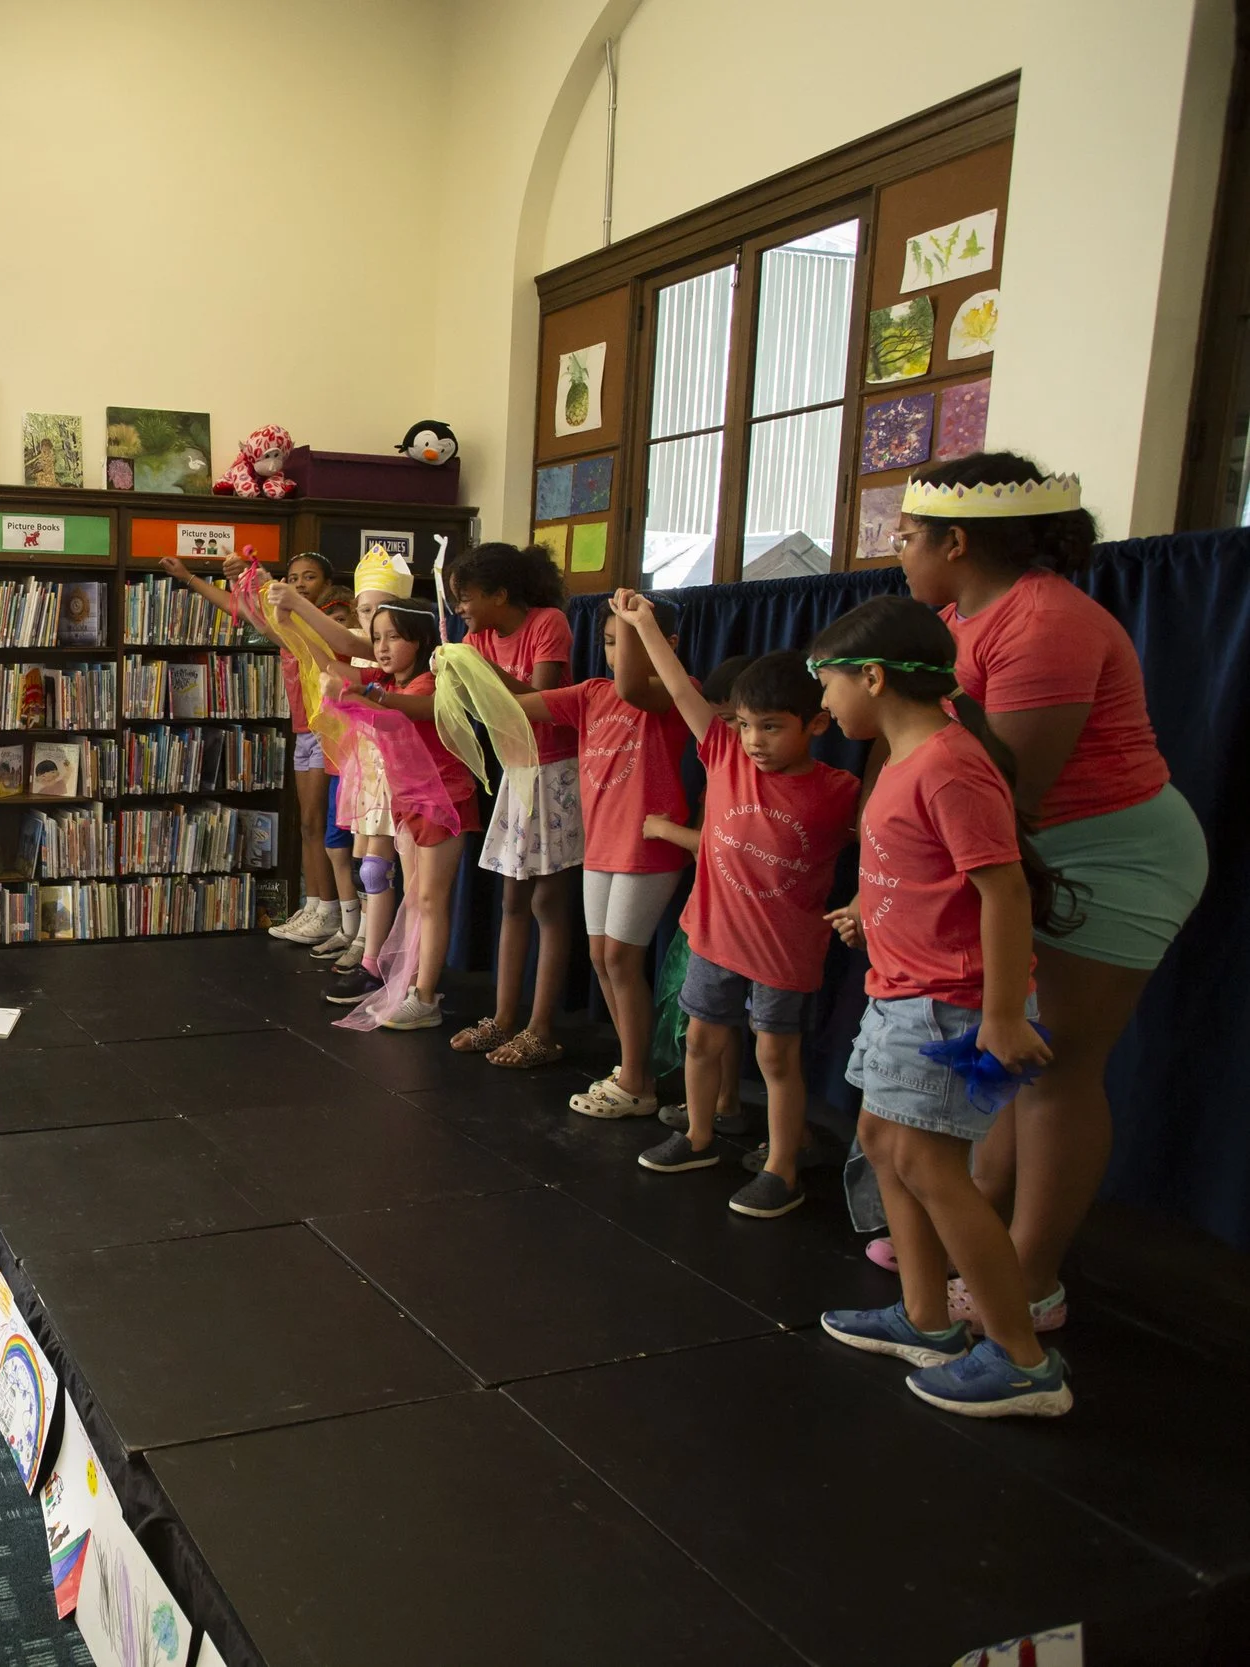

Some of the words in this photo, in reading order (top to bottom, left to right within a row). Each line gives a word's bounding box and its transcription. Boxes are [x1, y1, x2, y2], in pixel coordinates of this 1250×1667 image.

[7, 522, 35, 531] Picture
[37, 523, 60, 531] Books
[181, 529, 208, 538] Picture
[209, 530, 231, 540] Books
[586, 716, 604, 737] AUGH
[611, 757, 637, 786] RUCKUS
[724, 803, 761, 821] LAUGH
[761, 807, 792, 824] SING
[792, 821, 811, 854] MAKE
[713, 825, 741, 849] Studio
[743, 842, 811, 873] Playground
[758, 878, 797, 900] RUCKUS
